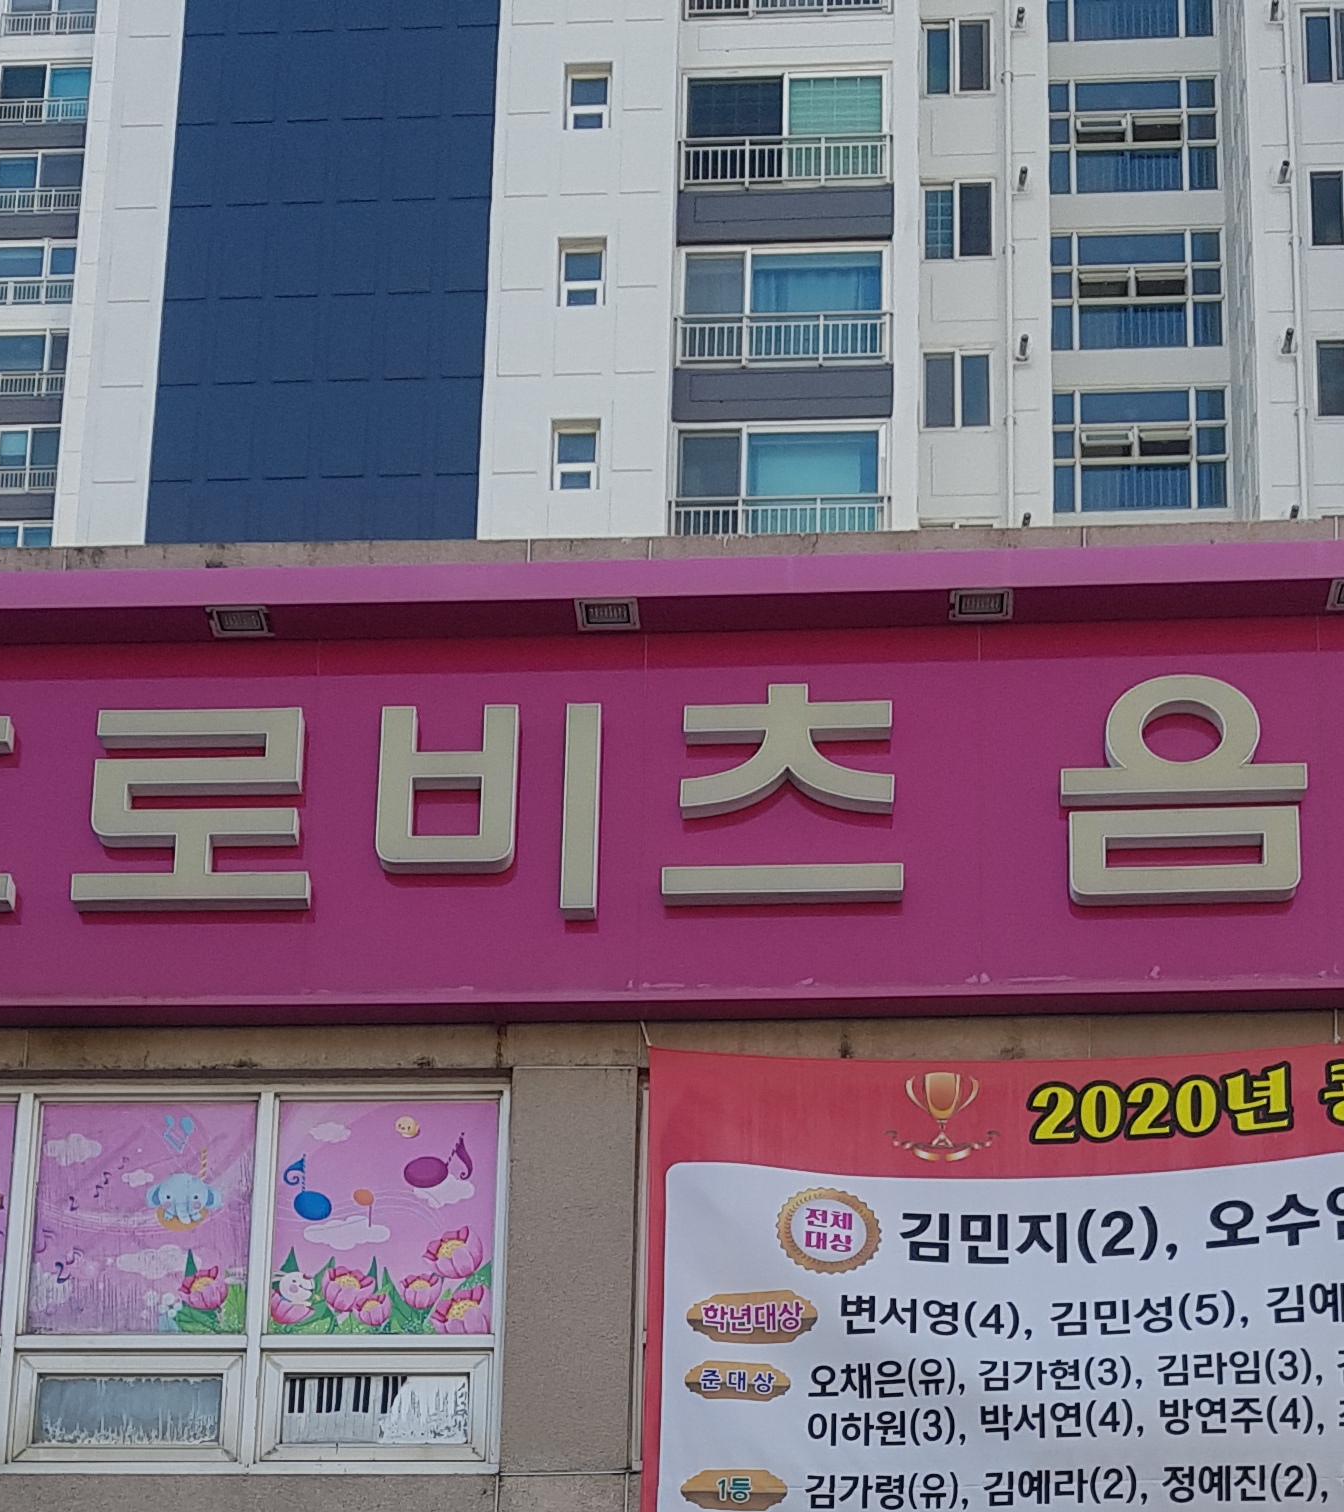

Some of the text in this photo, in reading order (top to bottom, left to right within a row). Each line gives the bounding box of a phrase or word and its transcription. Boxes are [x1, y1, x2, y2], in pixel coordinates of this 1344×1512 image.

[1026, 1062, 1292, 1144] 2020년
[805, 1208, 853, 1234] 전체
[805, 1230, 853, 1253] 대상
[898, 1206, 1179, 1265] 김민지(2),
[702, 1299, 805, 1335] 학년대상
[1049, 1289, 1250, 1338] 김민성(5),
[806, 1355, 967, 1402] 오채은(유),
[977, 1352, 1144, 1394] 김가현(3),
[1156, 1348, 1324, 1389] 김라임(3),
[806, 1405, 968, 1451] 이하원(3),
[979, 1396, 1146, 1443] 박서연(4),
[1158, 1394, 1326, 1439] 방연주(4),
[715, 1477, 753, 1503] 1등
[982, 1466, 1149, 1509] 김예라(2),
[1160, 1461, 1329, 1506] 정예진(2),
